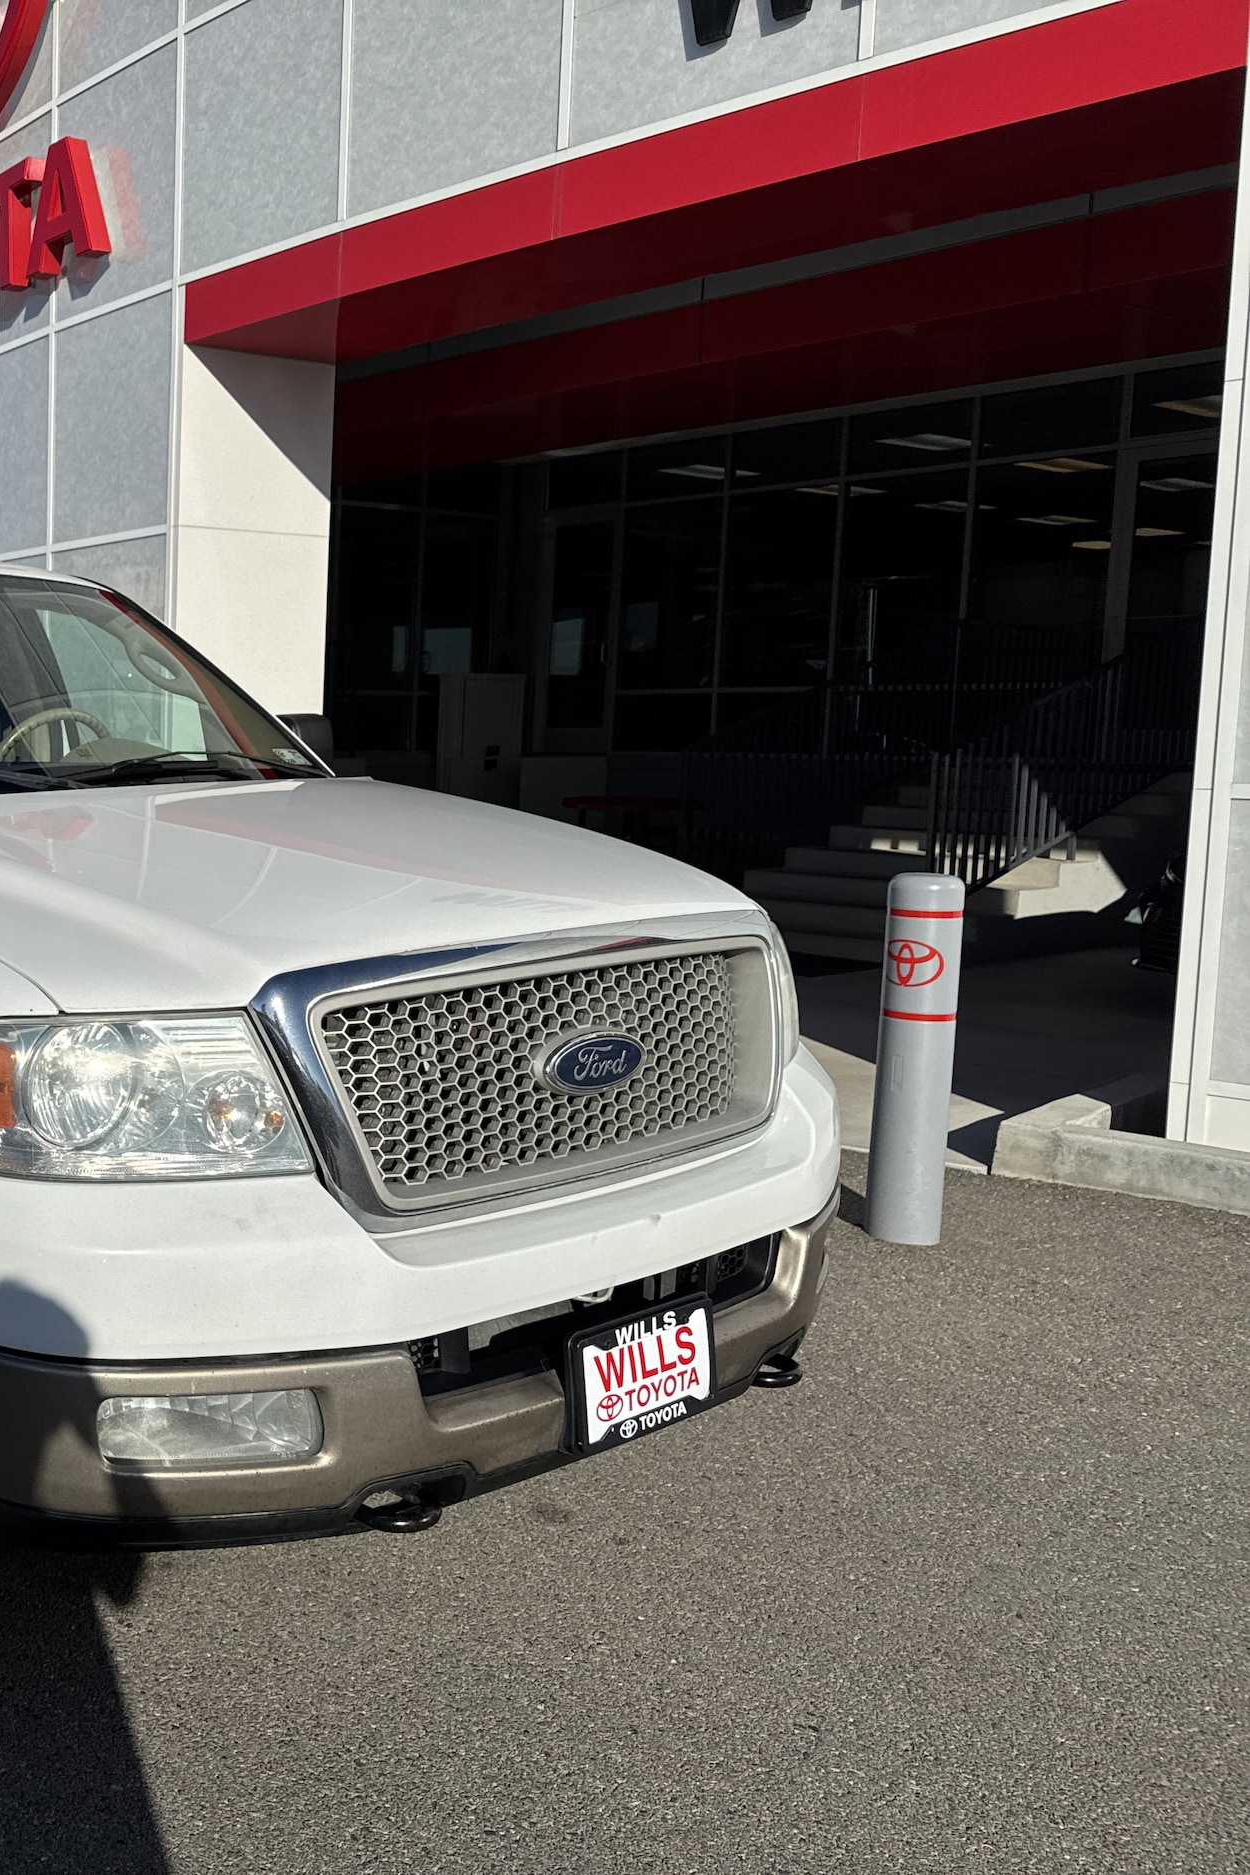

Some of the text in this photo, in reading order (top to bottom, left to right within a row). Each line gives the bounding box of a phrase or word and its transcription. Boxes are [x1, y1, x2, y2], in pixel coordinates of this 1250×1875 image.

[574, 1045, 628, 1081] Ford
[615, 1311, 677, 1346] WILLS
[593, 1326, 697, 1393] WILLS
[625, 1367, 700, 1411] TOYOTA
[639, 1401, 688, 1430] TOYOTA
